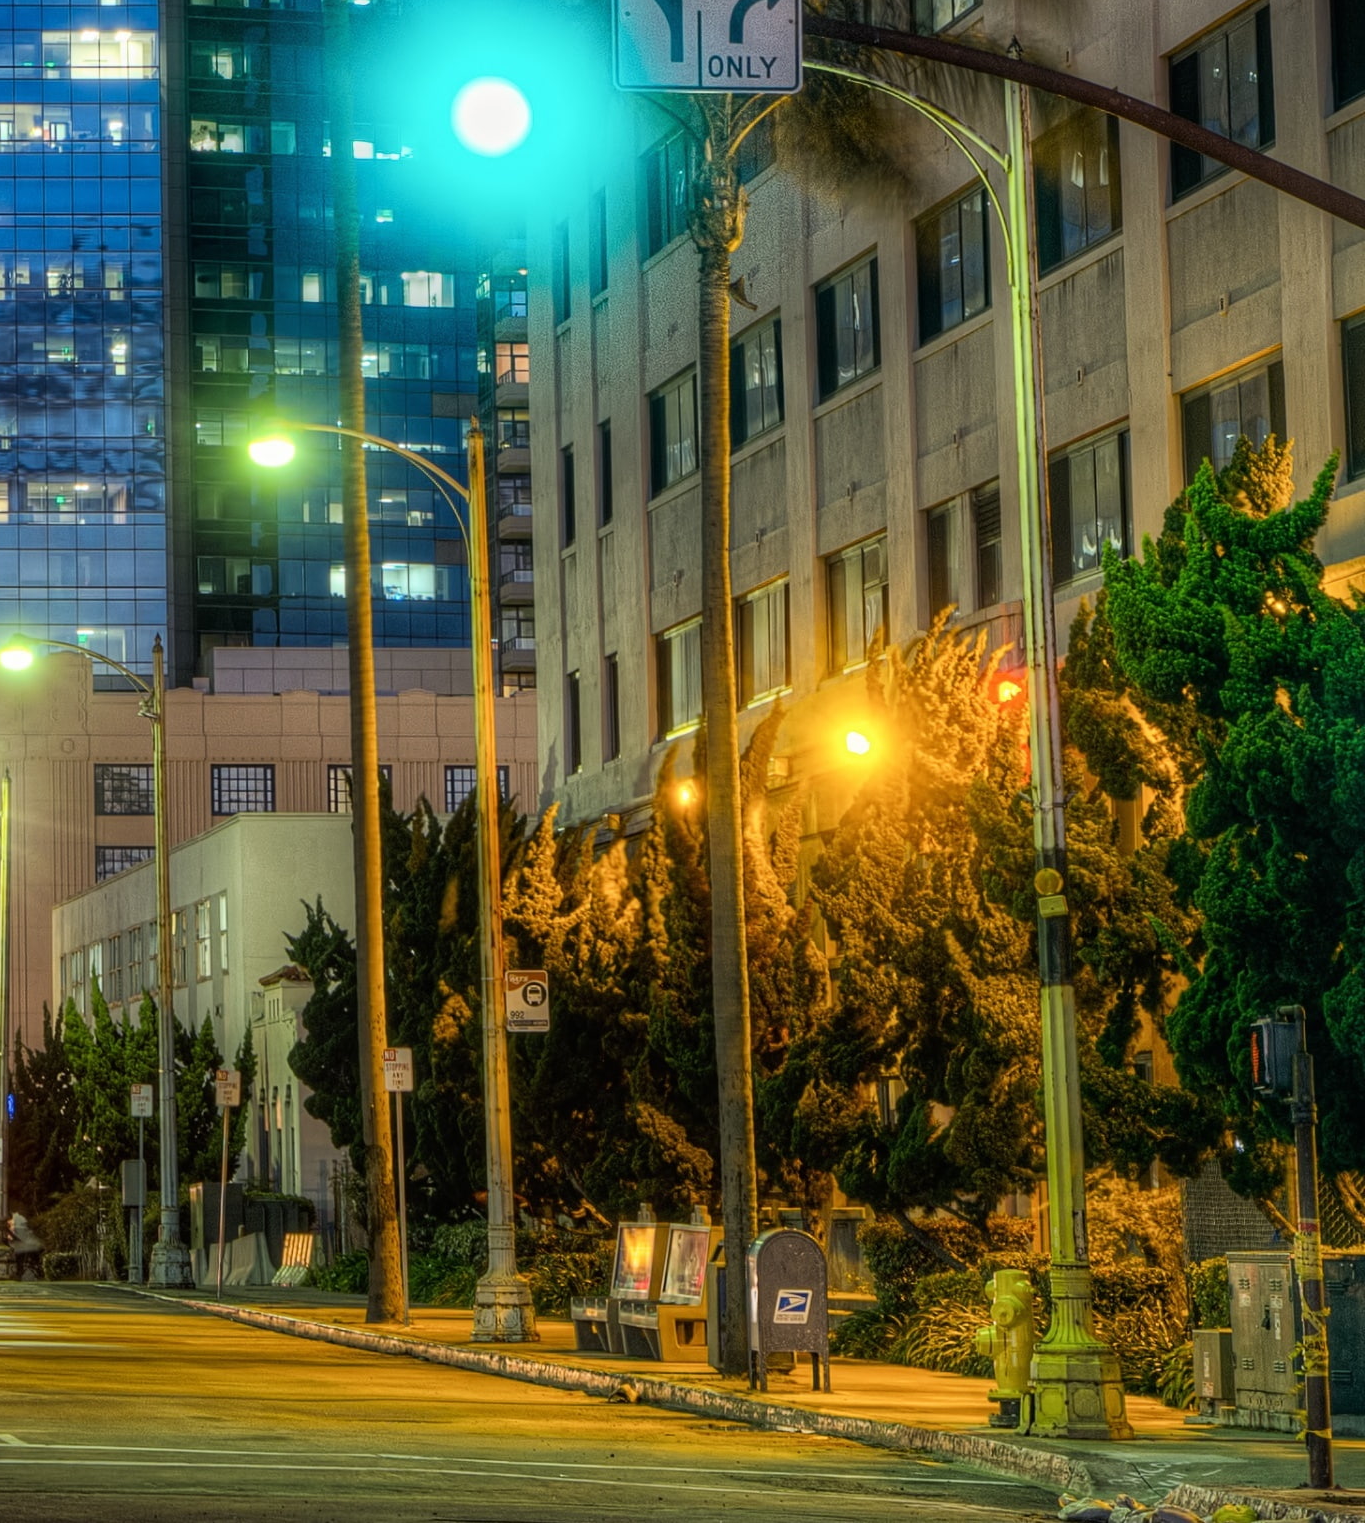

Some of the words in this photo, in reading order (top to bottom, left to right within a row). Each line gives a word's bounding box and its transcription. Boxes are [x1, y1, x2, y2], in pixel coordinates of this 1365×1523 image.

[708, 55, 777, 79] ONLY
[510, 1010, 525, 1019] 992
[384, 1051, 395, 1060] NO
[385, 1062, 409, 1071] STOPPING
